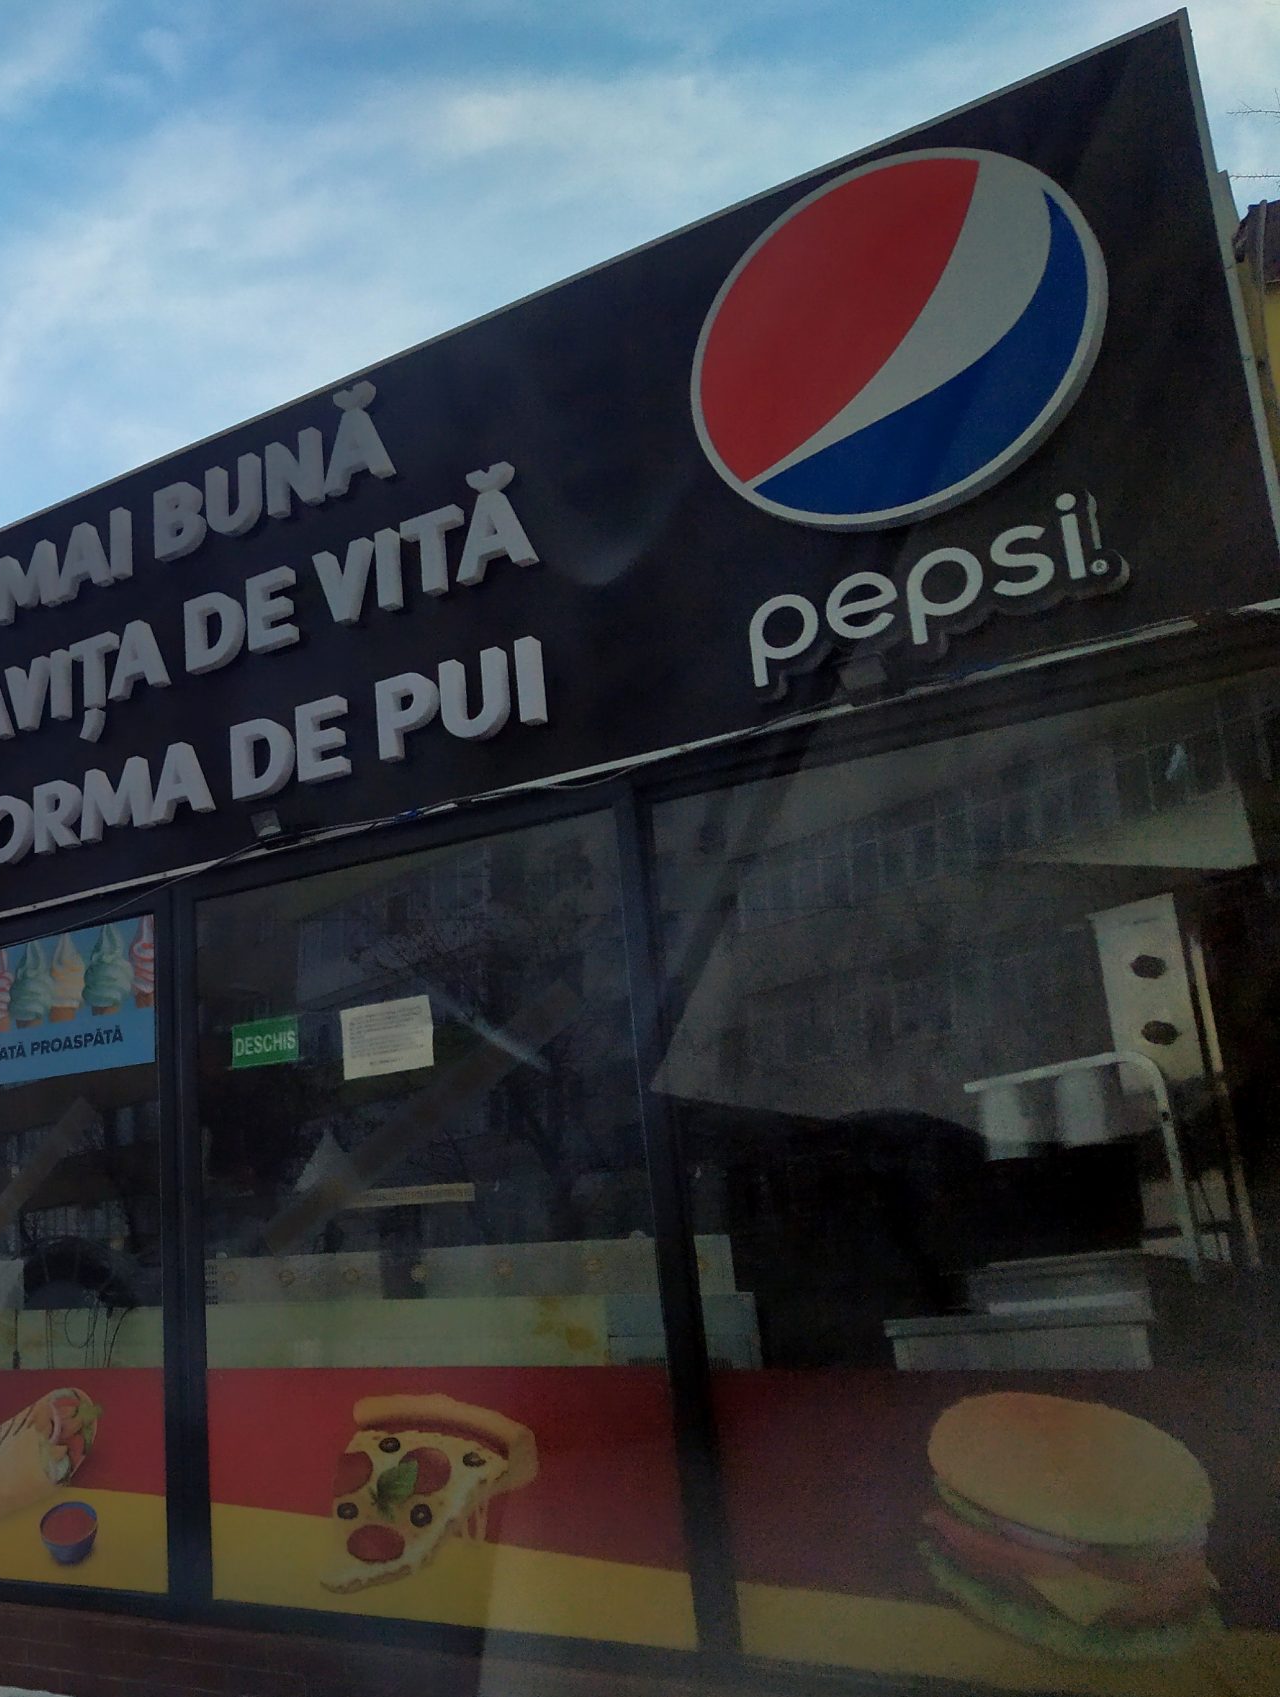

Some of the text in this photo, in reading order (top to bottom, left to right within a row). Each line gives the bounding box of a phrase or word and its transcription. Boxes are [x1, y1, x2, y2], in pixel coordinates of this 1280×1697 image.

[153, 380, 396, 562] BUNĂ
[184, 565, 300, 675] DE
[312, 461, 540, 624] VITĂ
[230, 694, 352, 801] DE
[374, 635, 548, 763] PUI
[30, 1025, 124, 1056] PROASPĂTĂ
[234, 1029, 297, 1058] DESCHIS
